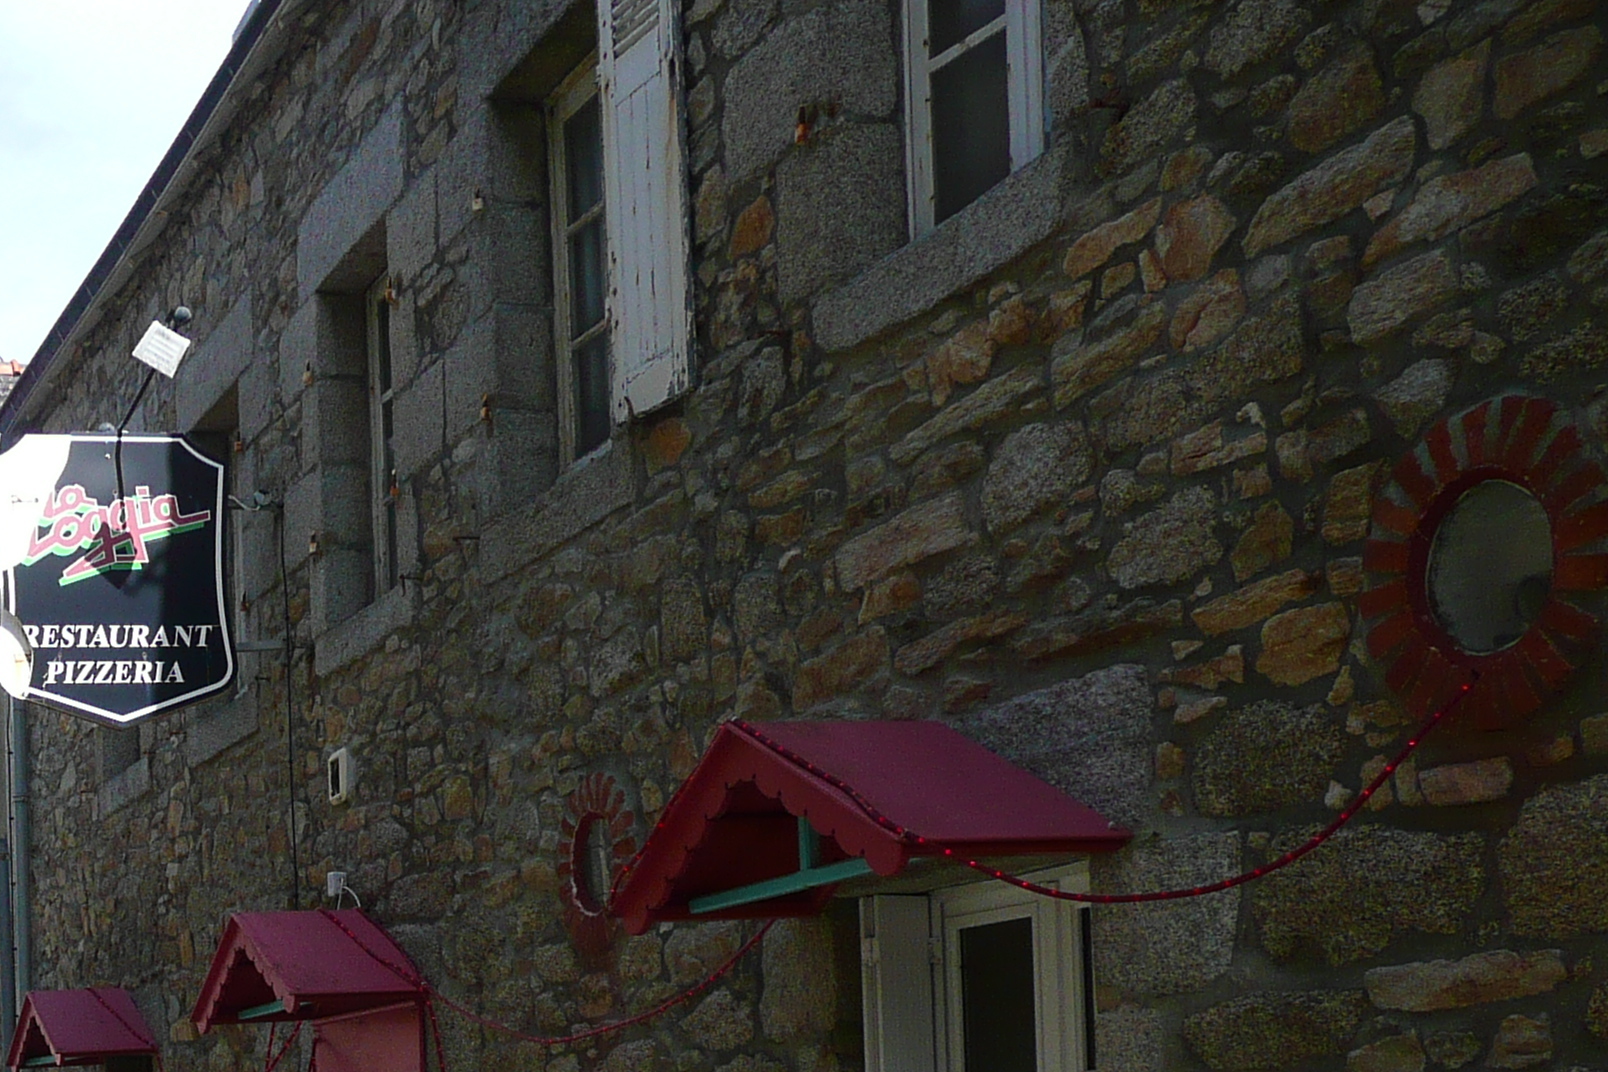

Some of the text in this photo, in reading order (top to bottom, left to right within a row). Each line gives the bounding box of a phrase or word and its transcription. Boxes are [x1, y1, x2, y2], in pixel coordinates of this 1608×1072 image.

[26, 485, 211, 580] Loggia
[22, 624, 213, 649] RESTAURANT
[46, 660, 185, 685] PIZZERIA
